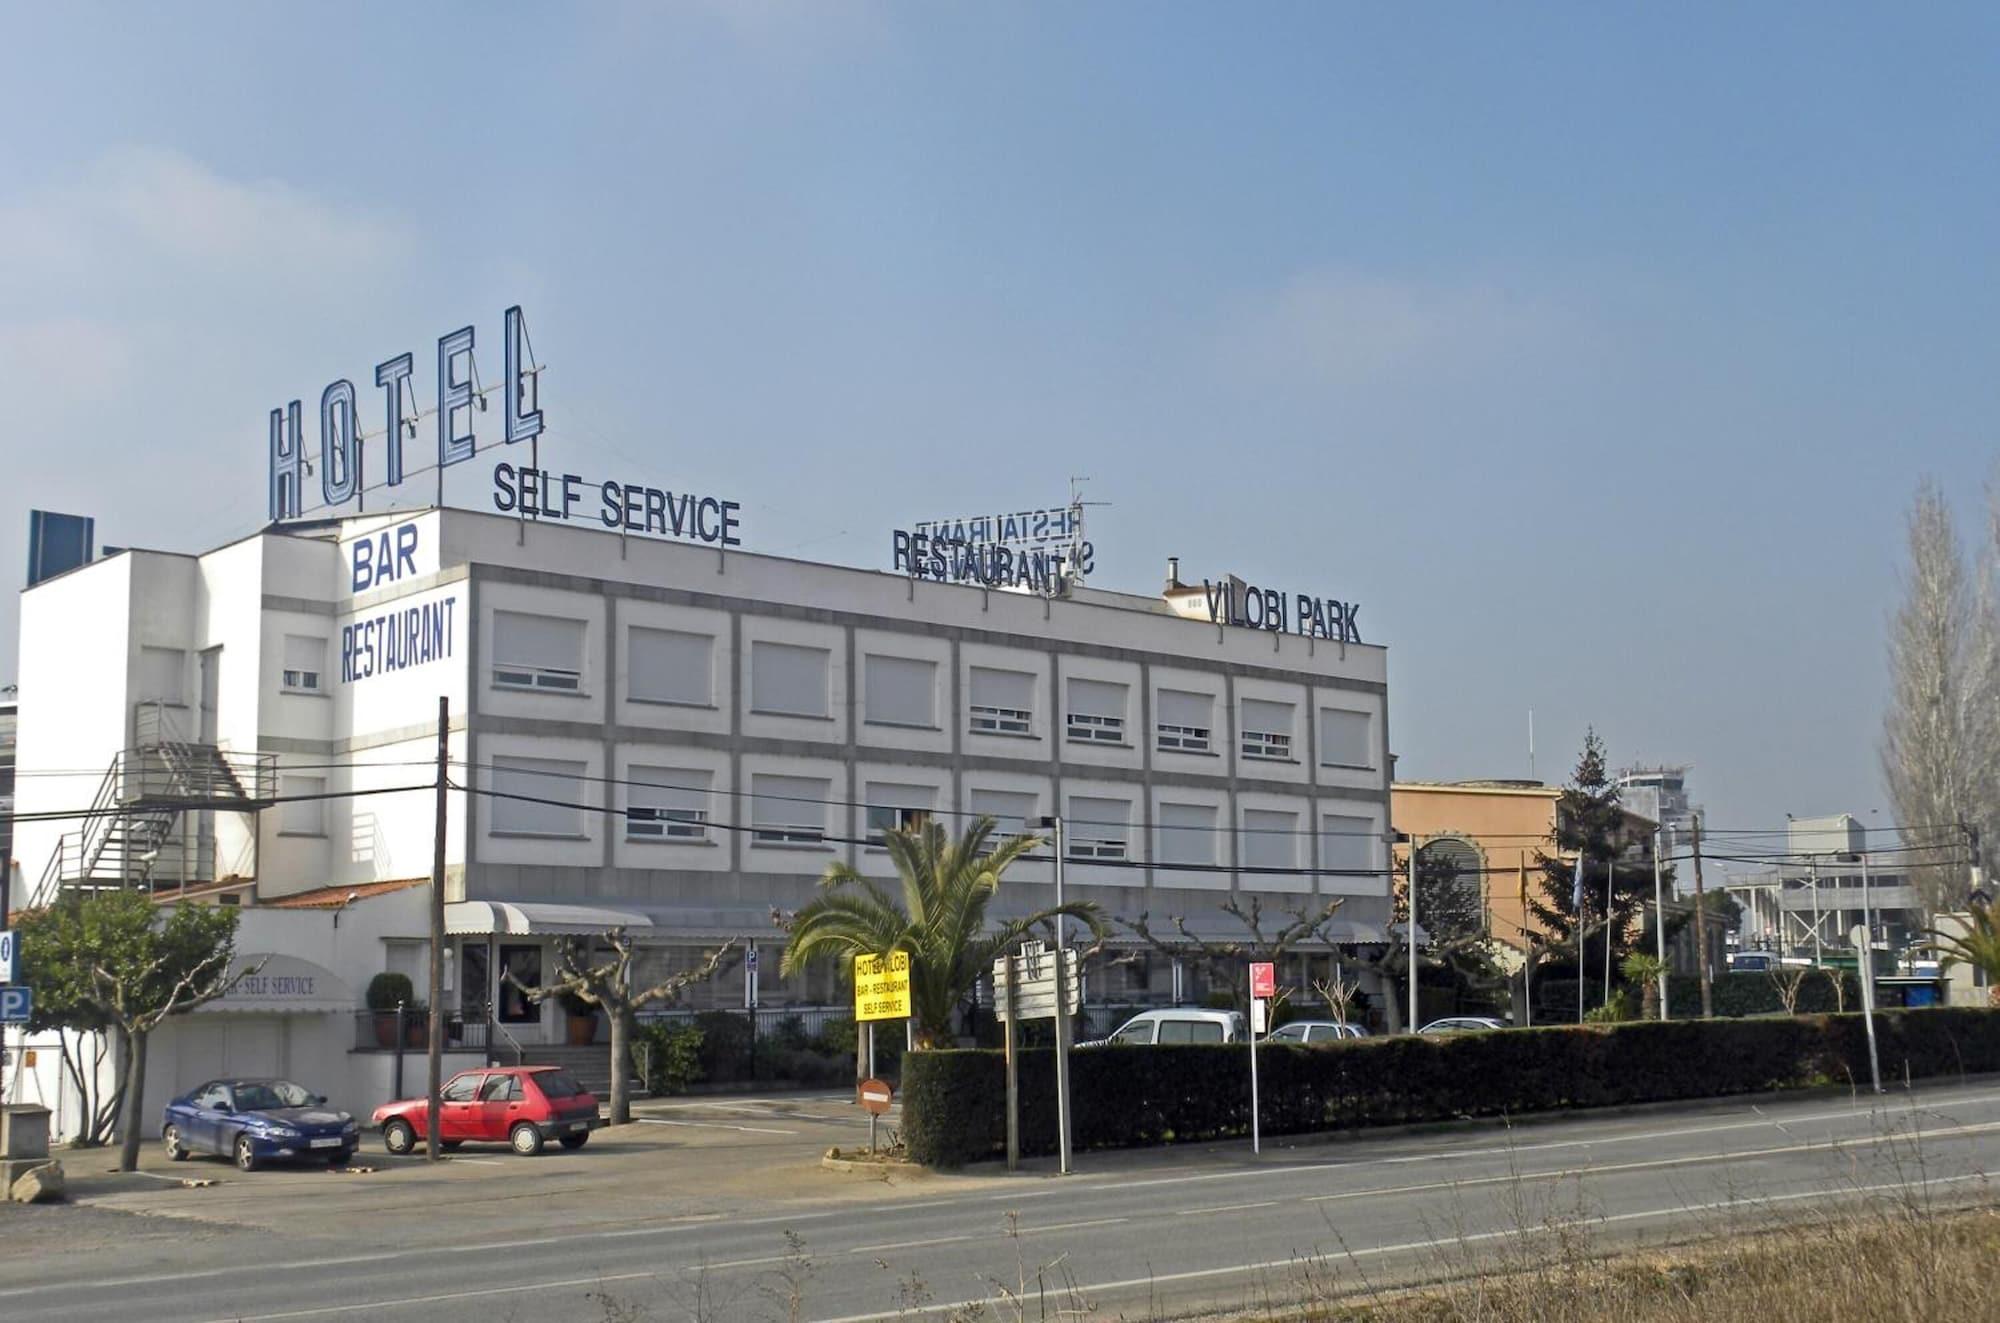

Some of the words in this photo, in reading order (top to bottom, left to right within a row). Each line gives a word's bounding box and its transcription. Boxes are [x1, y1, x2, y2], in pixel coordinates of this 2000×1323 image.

[269, 305, 544, 521] HOTEL
[493, 462, 583, 520] SELF
[600, 480, 742, 546] SERVICE
[352, 522, 419, 594] BAR
[893, 528, 1068, 600] RESTAURANT
[342, 596, 456, 684] RESTAURANT
[1203, 578, 1289, 633] VILOBI
[1296, 593, 1361, 645] PARK
[245, 976, 267, 995] SELF
[271, 976, 314, 995] SERVICE
